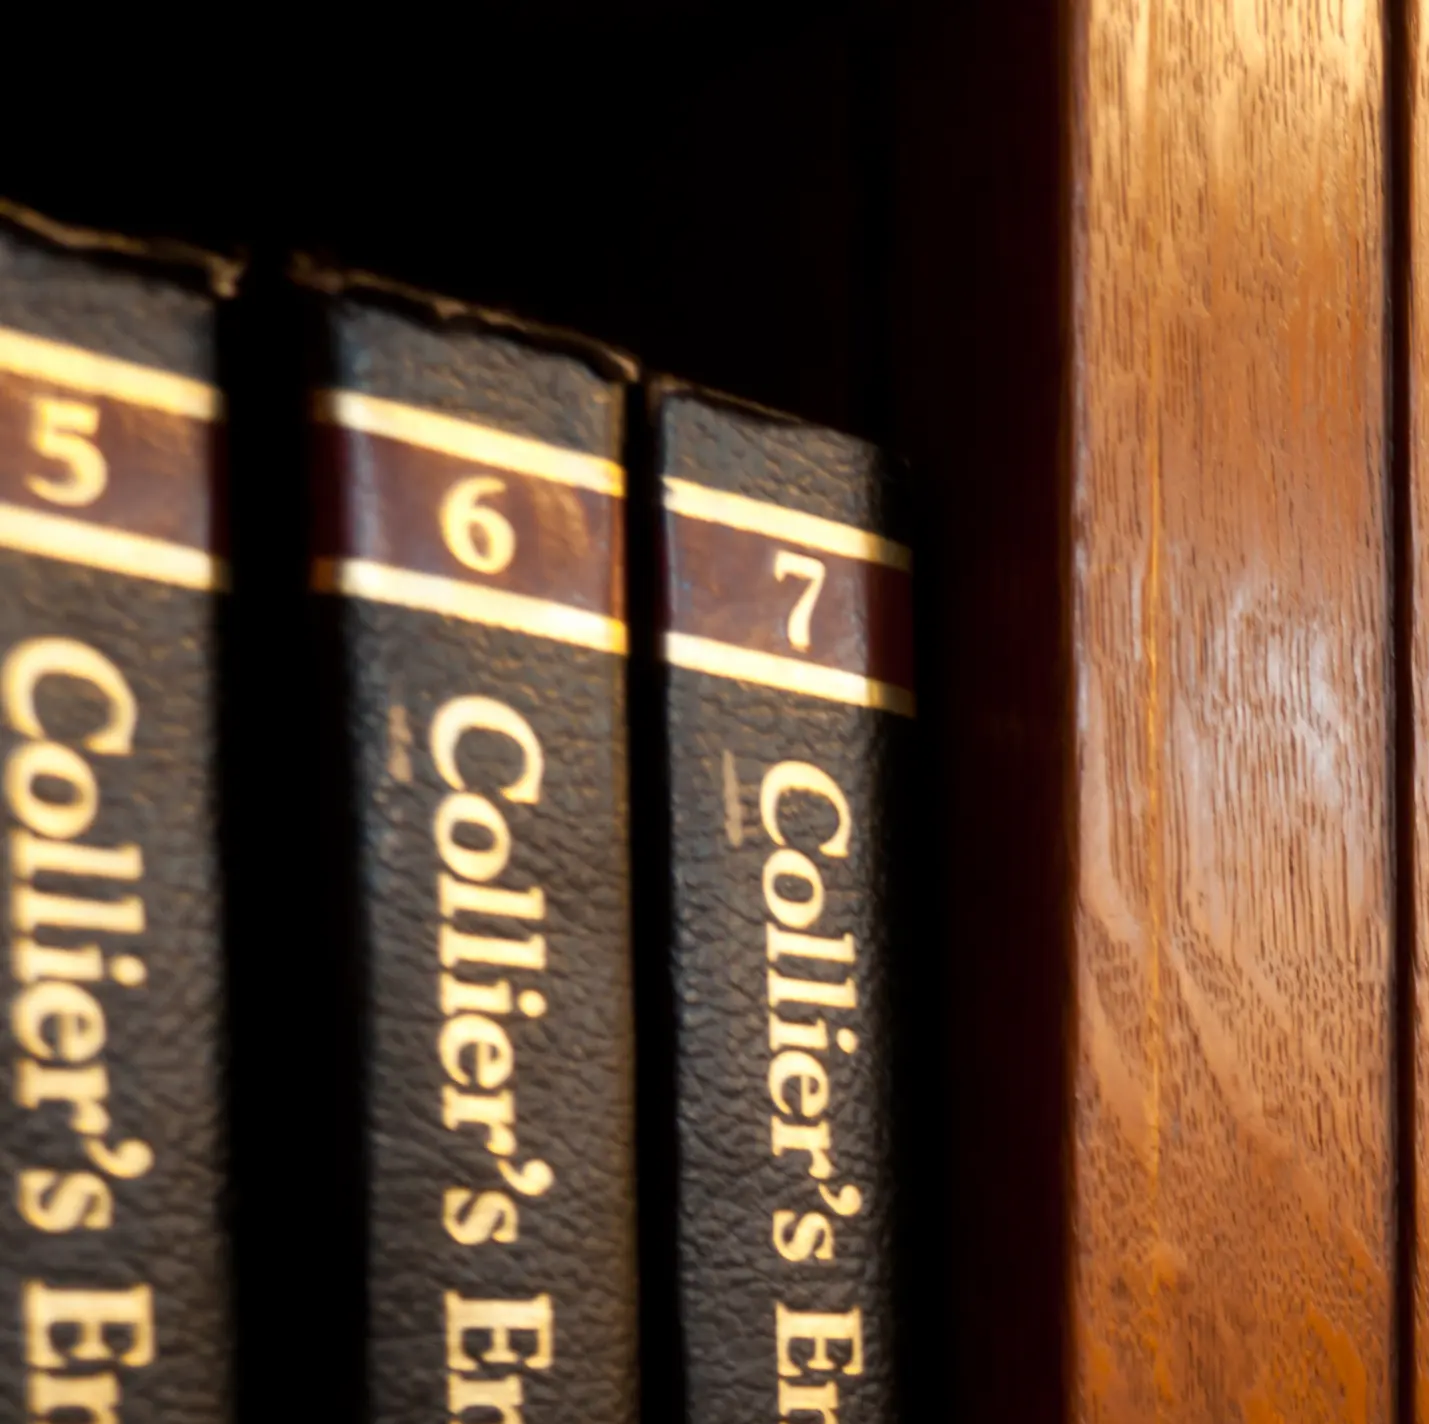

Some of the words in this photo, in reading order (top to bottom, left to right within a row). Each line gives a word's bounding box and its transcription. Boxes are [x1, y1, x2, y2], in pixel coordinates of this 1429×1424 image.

[22, 399, 108, 508] 5
[438, 475, 517, 576] 6
[772, 550, 826, 651] 7
[0, 635, 154, 1234] Collier's
[428, 695, 555, 1246] Collier's
[758, 759, 864, 1264] Collier's
